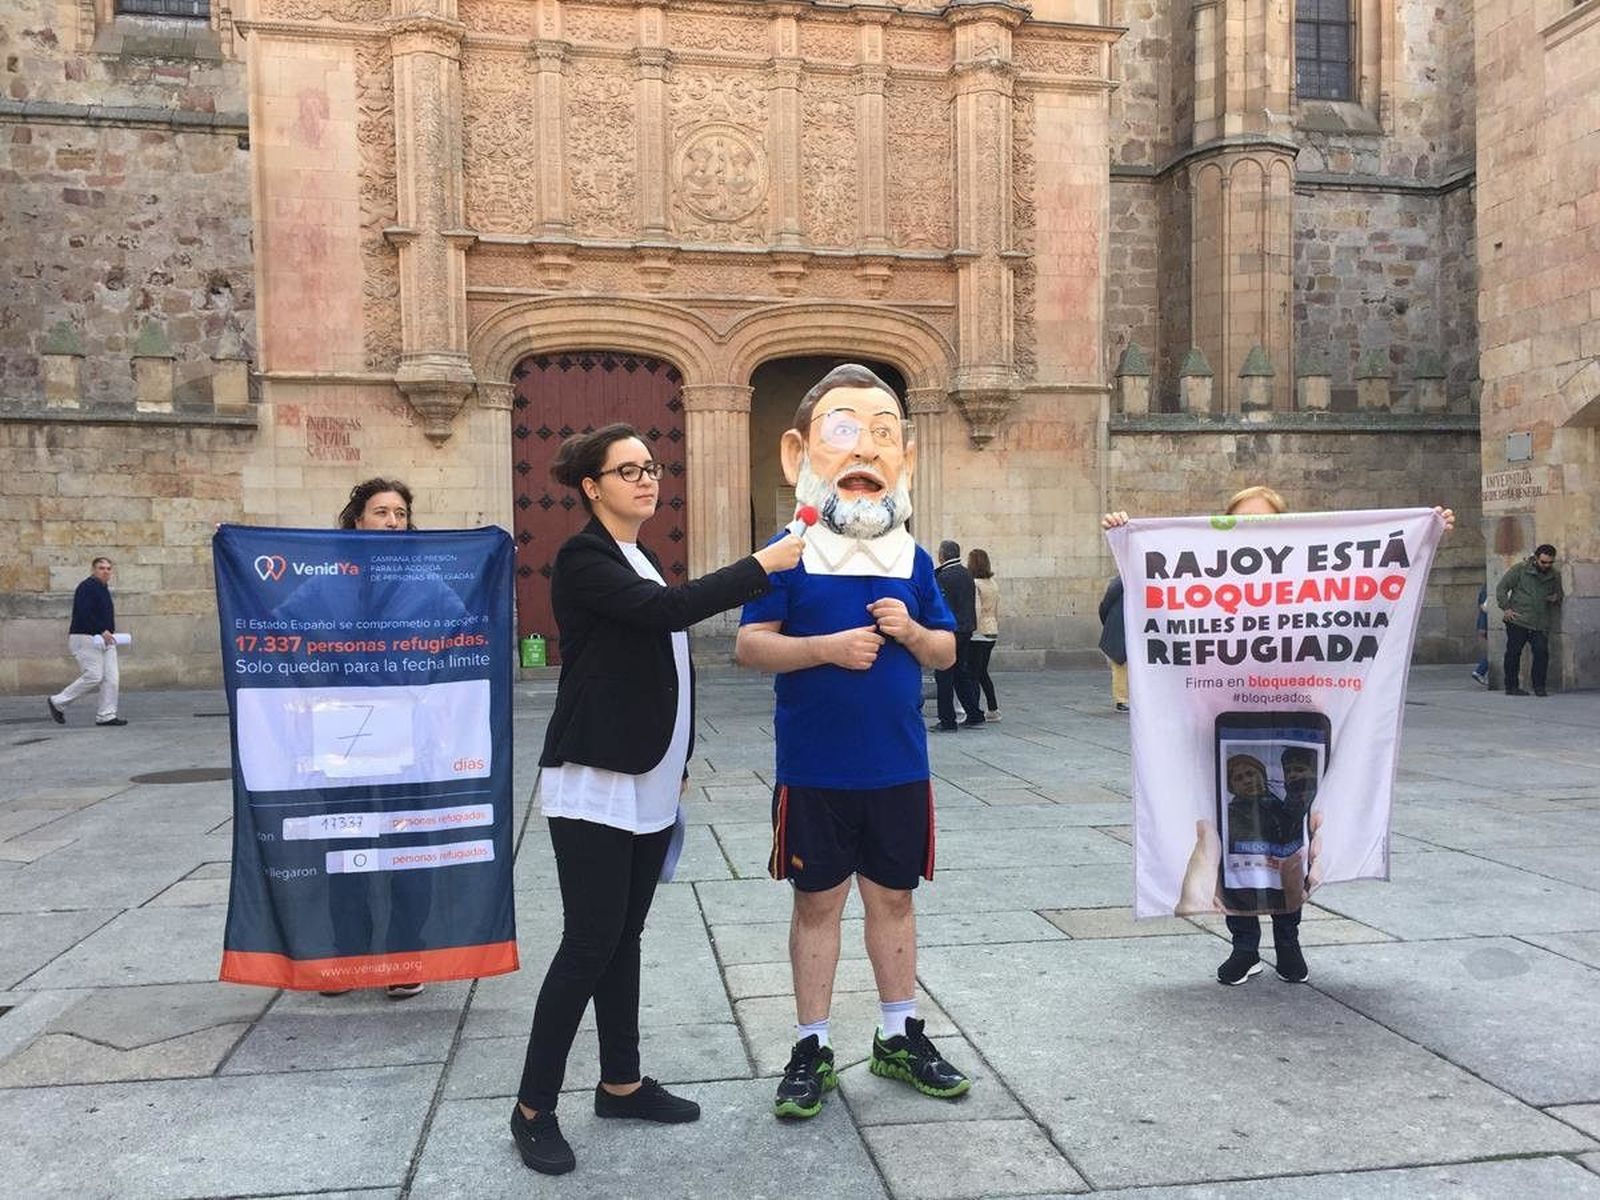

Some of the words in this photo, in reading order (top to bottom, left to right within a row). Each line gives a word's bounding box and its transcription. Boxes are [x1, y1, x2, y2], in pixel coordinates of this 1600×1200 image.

[1145, 545, 1294, 580] RAJOY
[1307, 529, 1410, 572] ESTÁ
[292, 562, 360, 576] VenidYa
[1146, 575, 1406, 614] BLOQUEANDO
[235, 618, 246, 629] El
[249, 619, 288, 630] Estado
[339, 621, 352, 630] se
[1143, 618, 1160, 633] A
[1166, 616, 1235, 634] MILES
[1242, 615, 1270, 632] DE
[1277, 610, 1389, 630] PERSONA
[235, 635, 301, 653] 17.337
[307, 639, 386, 656] personas
[392, 632, 489, 653] refugiadas.
[1147, 634, 1379, 666] REFUGIADA
[235, 659, 273, 674] Solo
[278, 659, 339, 677] quedan
[344, 661, 380, 676] para
[384, 658, 397, 672] la
[402, 657, 444, 672] fecha
[1185, 677, 1224, 689] Firma
[1227, 676, 1245, 687] en
[1248, 674, 1362, 691] bloqueados.org
[1232, 691, 1312, 705] #bloqueados
[336, 704, 375, 760] 7
[392, 853, 437, 866] personas
[269, 867, 317, 881] llegaron
[321, 960, 423, 978] www.venidya.org
